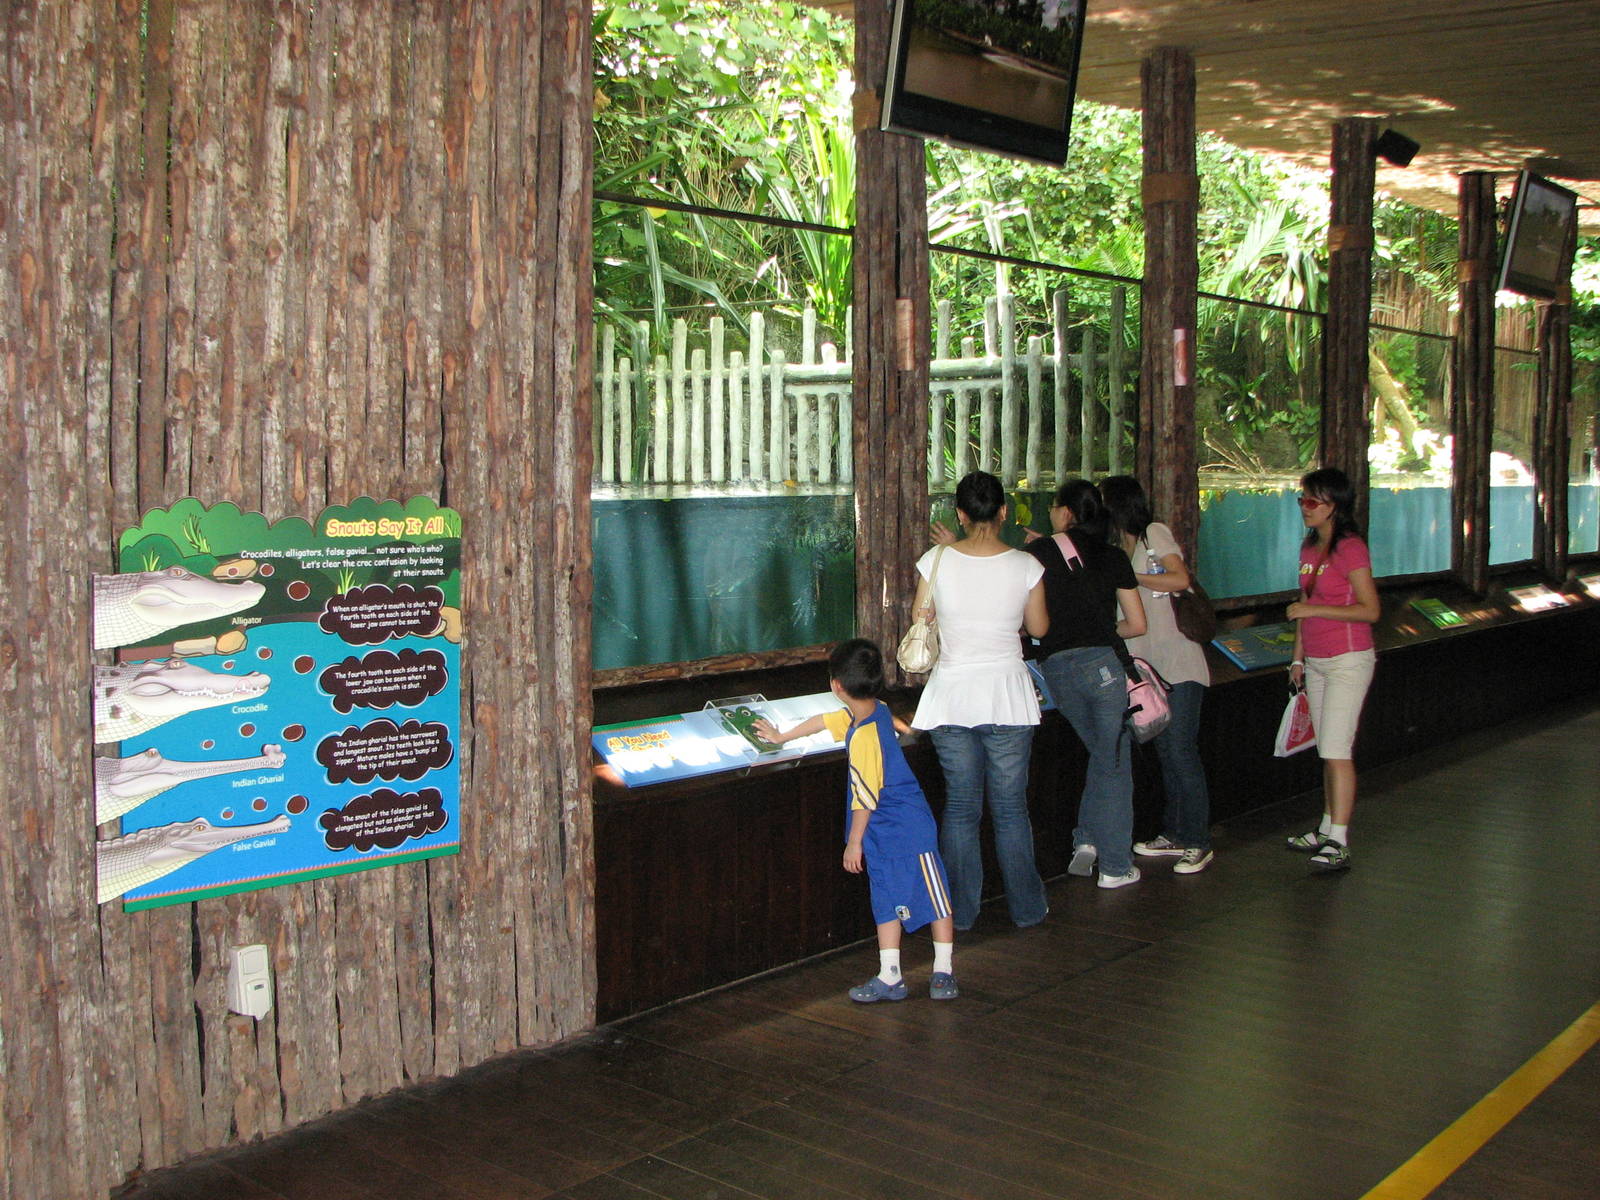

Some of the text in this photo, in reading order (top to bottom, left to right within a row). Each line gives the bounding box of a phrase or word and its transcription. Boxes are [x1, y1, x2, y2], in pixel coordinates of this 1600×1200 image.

[326, 516, 444, 540] Snouts Say It All
[241, 550, 284, 559] Crocodiles,
[286, 549, 324, 559] alligators,
[302, 560, 320, 569] Let's
[322, 559, 341, 568] clear
[343, 559, 355, 567] the
[374, 558, 408, 567] confusion
[409, 557, 418, 566] by
[420, 556, 444, 565] looking
[359, 603, 387, 613] alligator's
[232, 617, 262, 626] Alligator
[340, 613, 360, 621] fourth
[348, 670, 367, 679] fourth
[363, 679, 373, 687] jaw
[351, 686, 381, 694] crocodile's
[232, 703, 268, 714] Crocodile
[368, 736, 388, 746] gharial
[607, 729, 672, 748] All You Need
[346, 747, 366, 757] longest
[336, 758, 355, 766] zipper.
[357, 755, 378, 763] Mature
[232, 773, 284, 788] Indian Gharial
[390, 808, 405, 816] false
[406, 805, 422, 814] gavial
[335, 822, 363, 832] elongated
[394, 822, 415, 832] gharial.
[232, 838, 276, 852] False Gavial
